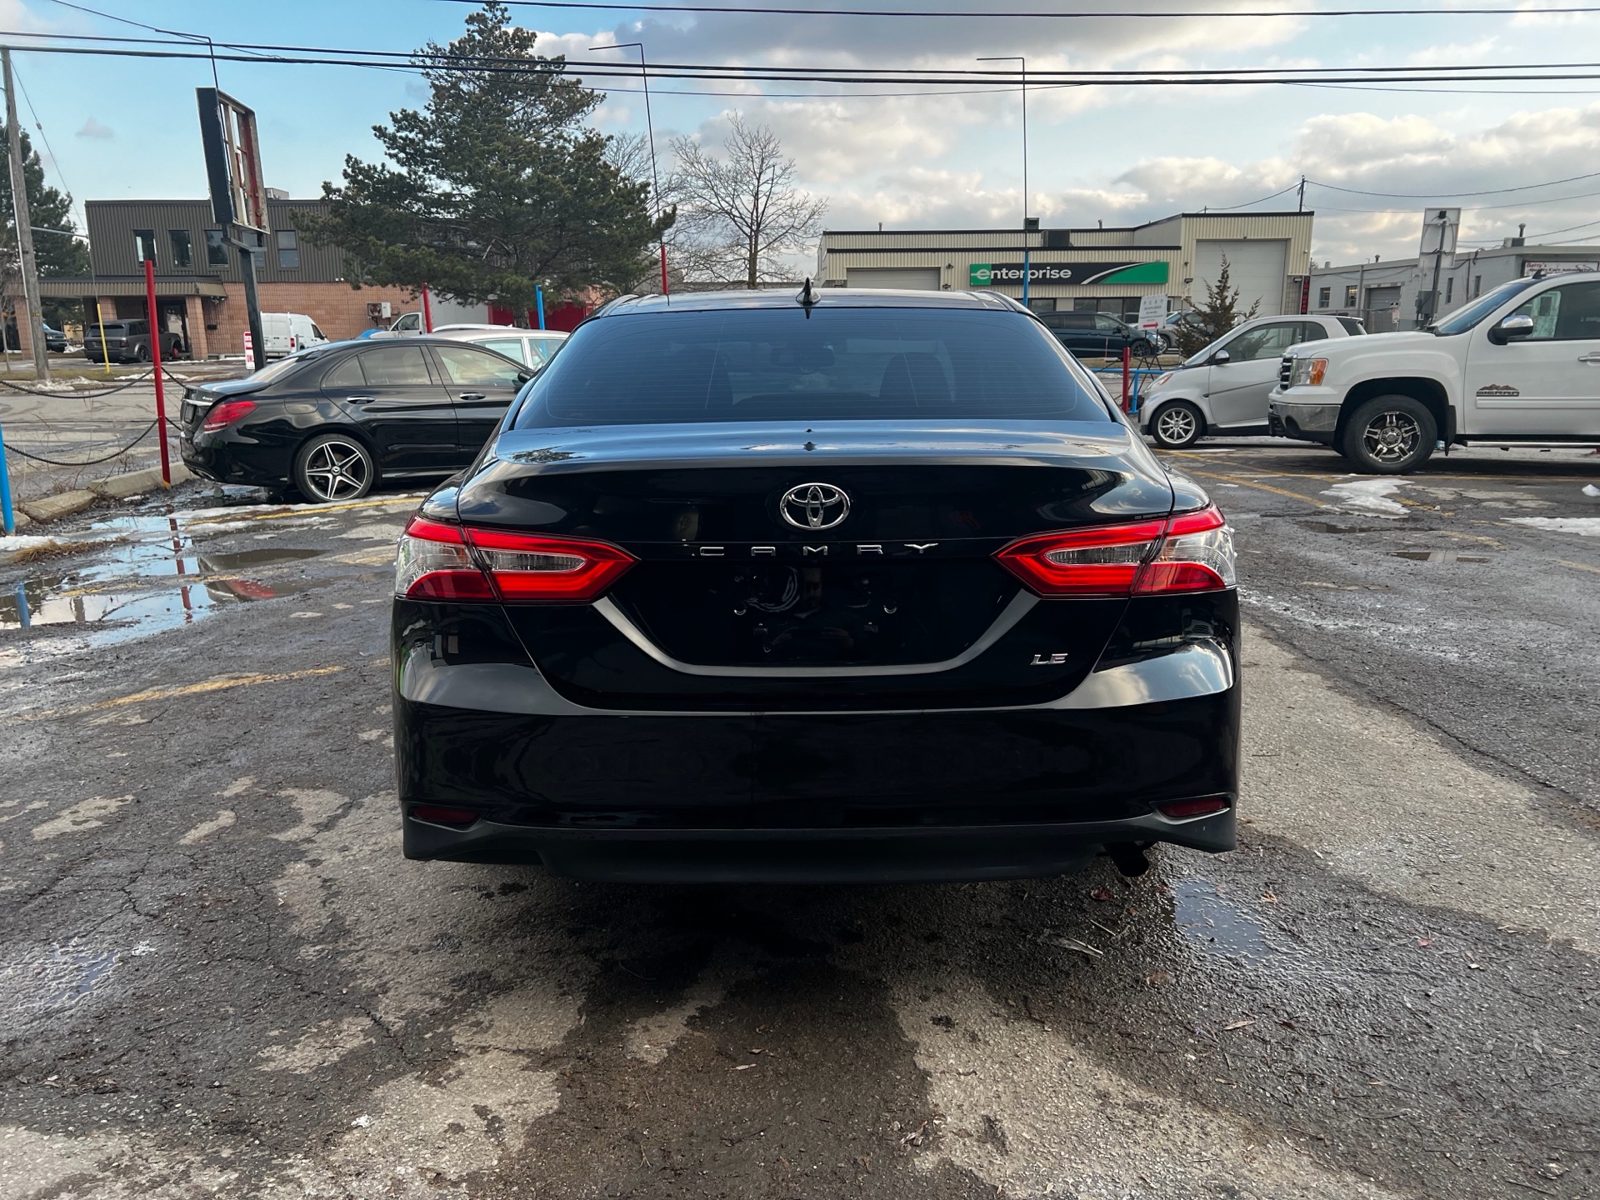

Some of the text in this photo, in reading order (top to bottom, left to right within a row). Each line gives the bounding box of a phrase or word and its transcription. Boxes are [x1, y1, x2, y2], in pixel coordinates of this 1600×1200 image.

[971, 266, 1072, 282] enterprise
[699, 542, 939, 557] CAMRY
[1029, 652, 1069, 666] LE
